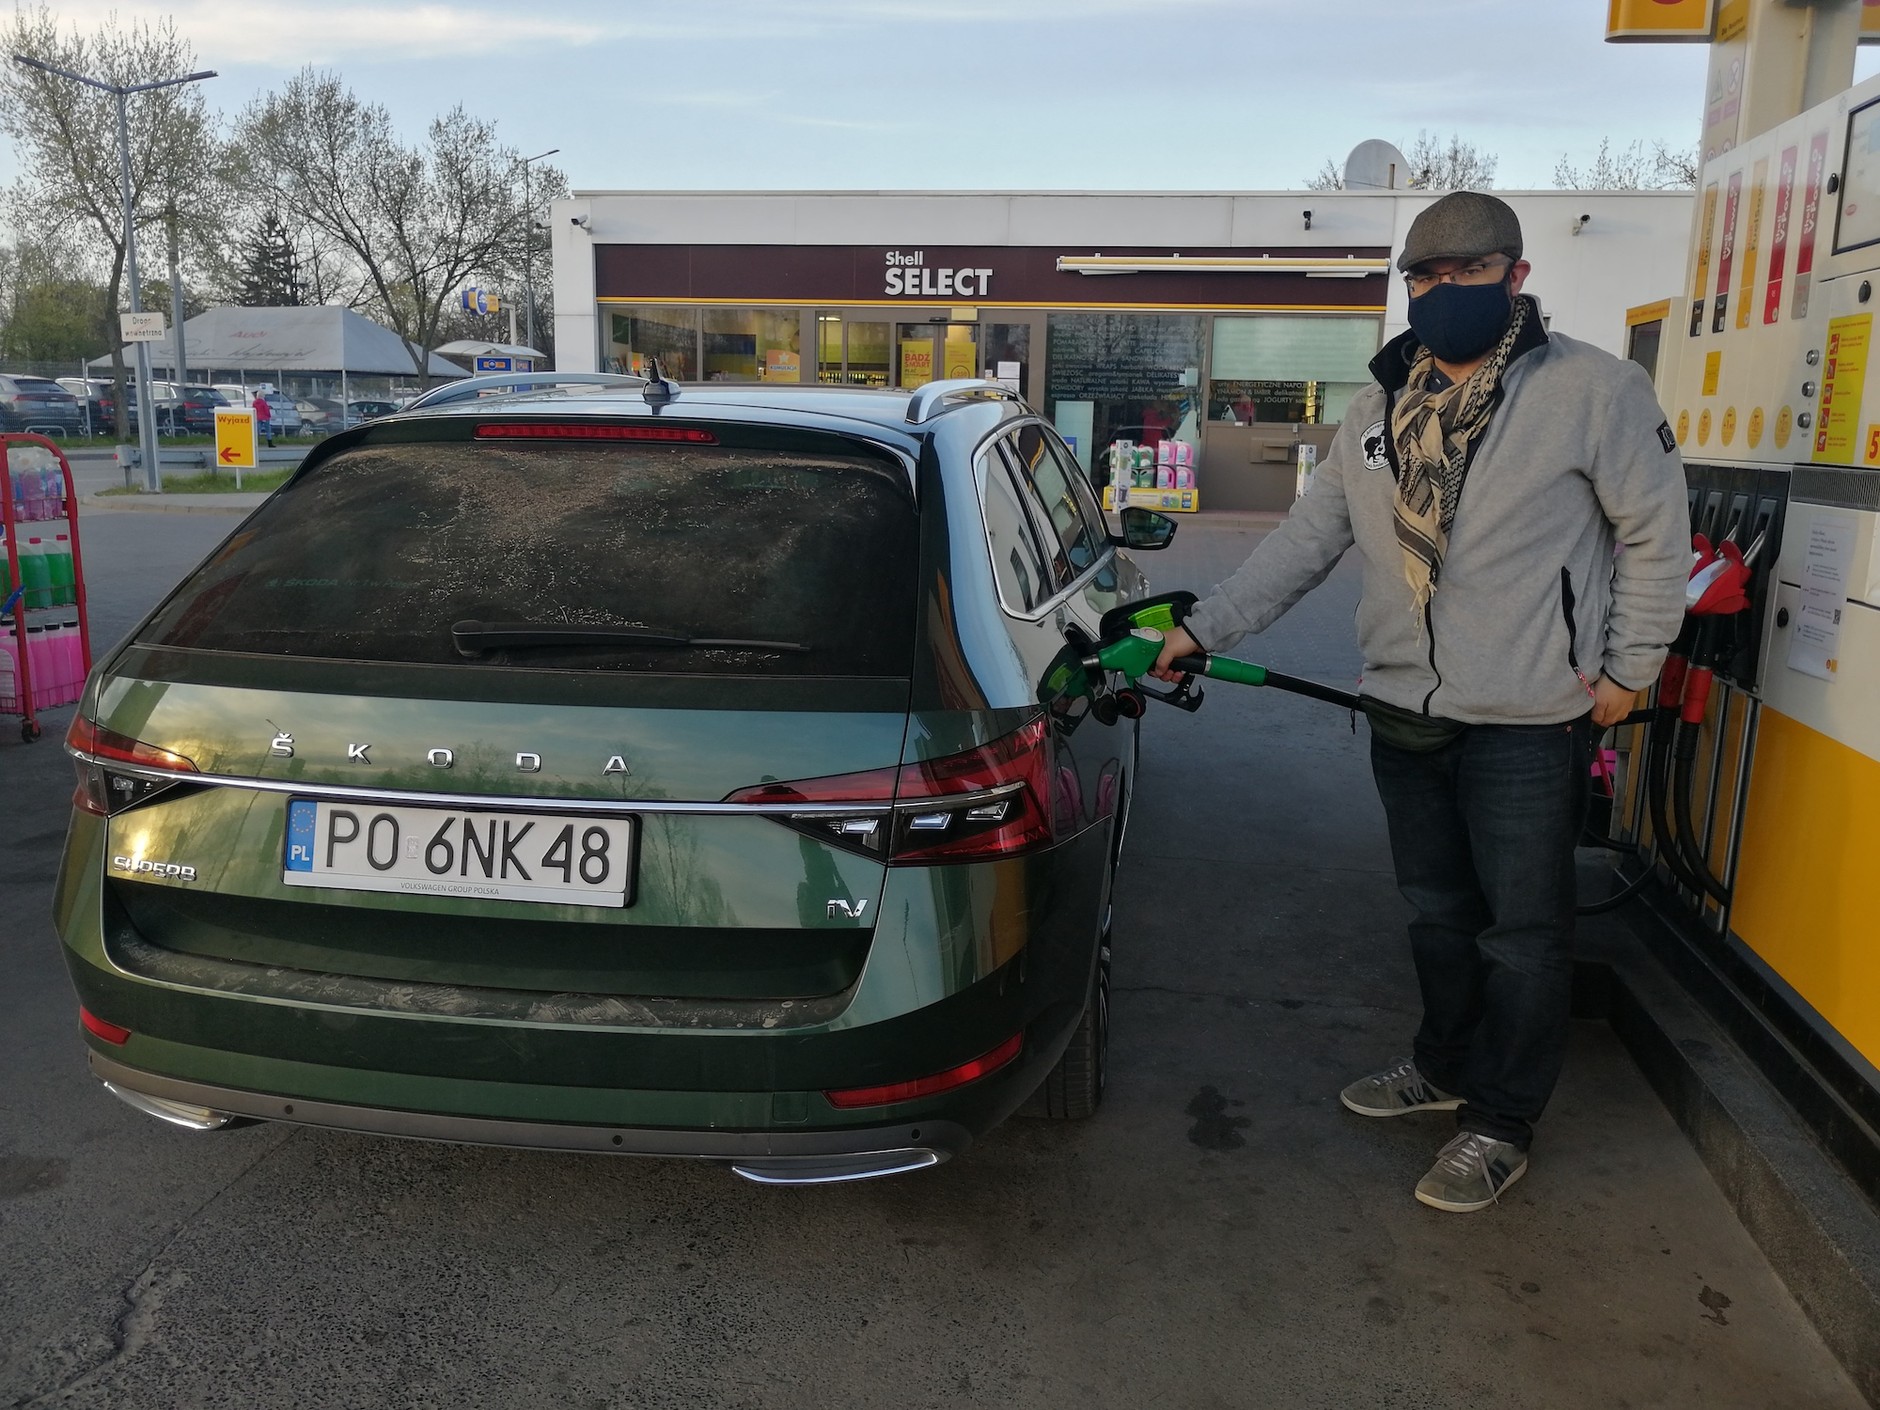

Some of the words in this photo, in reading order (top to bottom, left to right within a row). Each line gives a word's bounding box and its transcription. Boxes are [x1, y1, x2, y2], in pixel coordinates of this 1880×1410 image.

[1779, 167, 1792, 242] V-Power
[1807, 151, 1822, 233] V-Power
[1725, 191, 1738, 259] V-Power
[885, 251, 923, 265] Shell
[884, 267, 993, 296] SELECT
[217, 415, 250, 425] Wyjazd
[271, 733, 631, 777] ŠKODA
[291, 844, 310, 862] PL
[326, 809, 399, 871] PO
[425, 816, 610, 885] 6NK48
[113, 855, 197, 882] SUPERB
[400, 882, 447, 892] VOLKSWAGEN
[447, 885, 473, 894] GROUP
[473, 887, 500, 896] POLSKA
